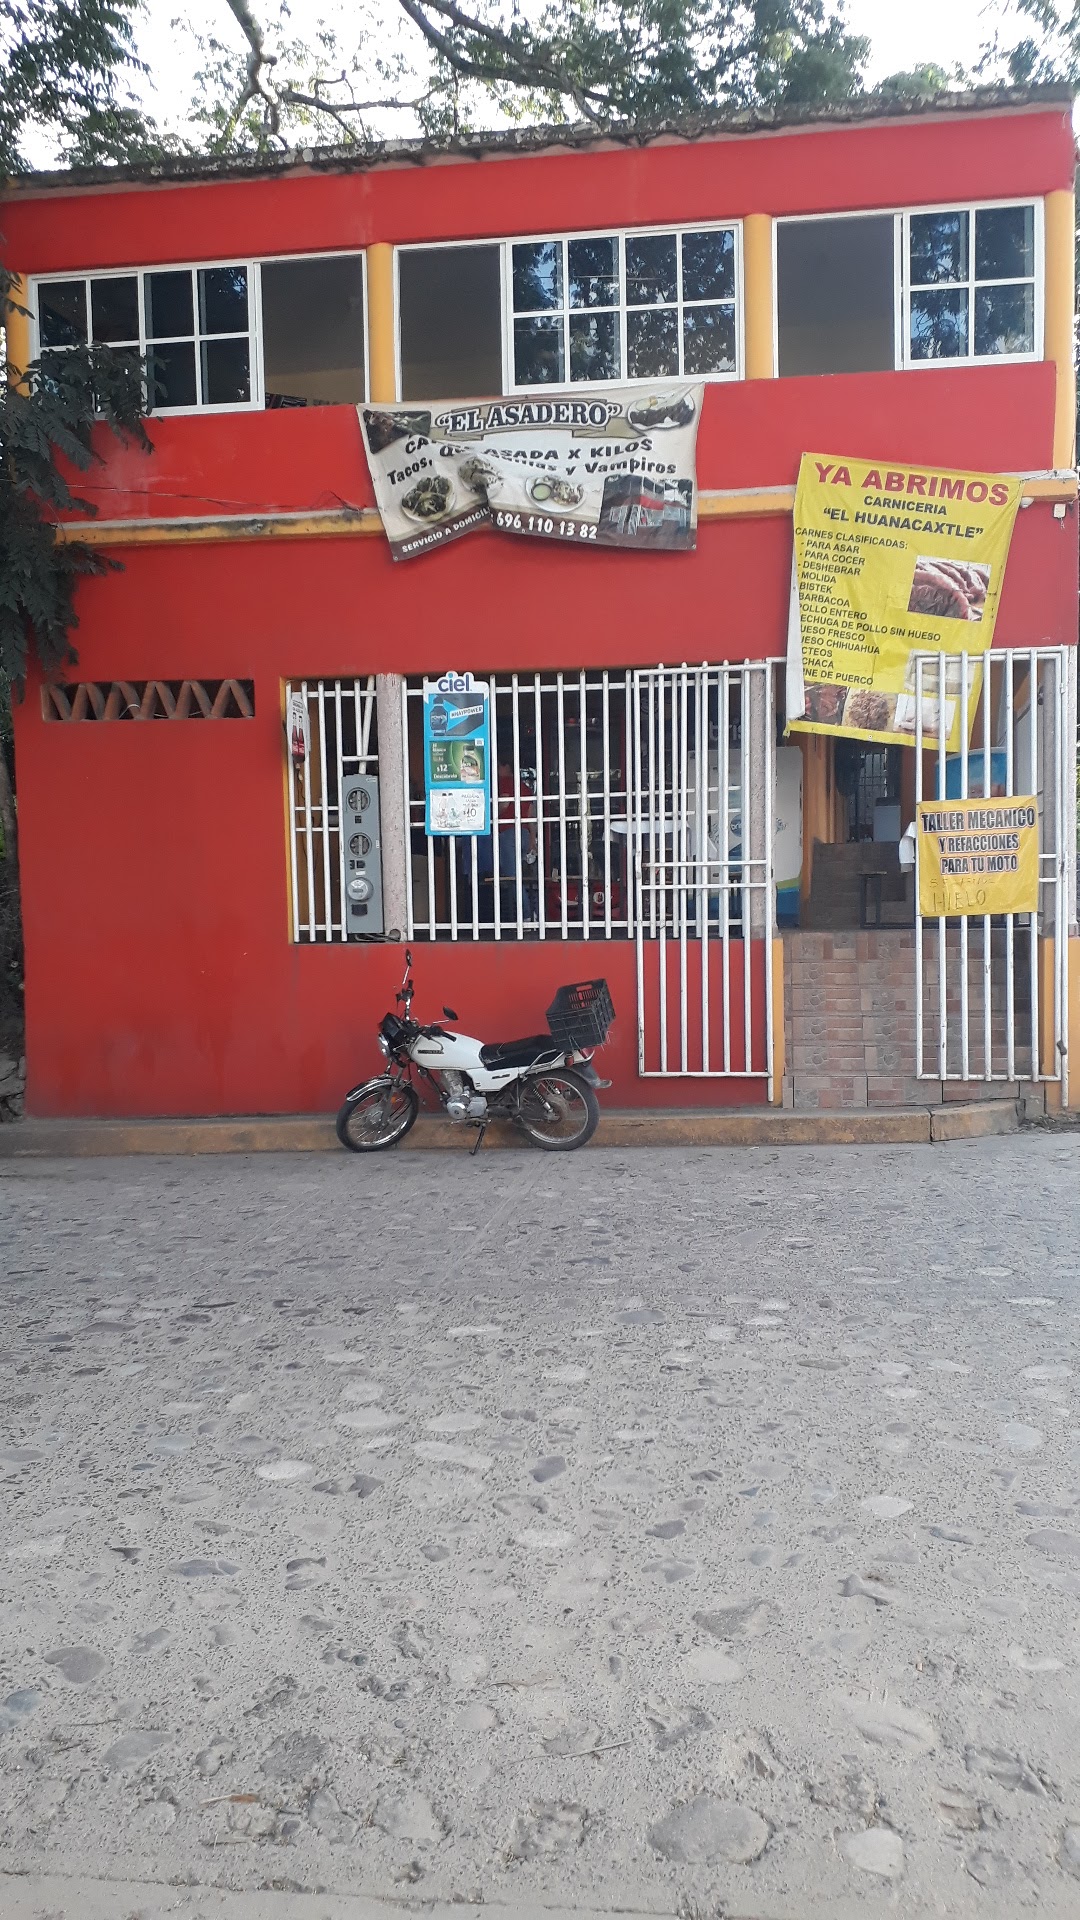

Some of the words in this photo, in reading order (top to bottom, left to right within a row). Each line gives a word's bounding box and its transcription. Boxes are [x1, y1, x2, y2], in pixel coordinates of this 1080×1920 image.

[568, 448, 580, 460] X
[591, 438, 653, 458] KILOS
[387, 457, 433, 485] Tacos,
[585, 457, 677, 474] Vampiros
[814, 462, 852, 486] YA
[861, 469, 1009, 506] ABRIMOS
[864, 495, 947, 516] CARNICERIA
[497, 512, 522, 529] 696
[528, 516, 553, 534] 110
[559, 520, 575, 536] 13
[580, 525, 597, 540] 82
[795, 527, 834, 540] CARNES
[401, 531, 443, 553] SERVICIO
[445, 527, 452, 536] A
[806, 539, 831, 551] PARA
[833, 543, 860, 554] ASAR
[804, 550, 829, 562] PARA
[831, 554, 866, 566] COCER
[802, 560, 861, 576] DESHEBRAR
[801, 571, 837, 584] MOLIDA
[799, 581, 833, 594] BISTEK
[798, 592, 850, 608] BARBACOA
[829, 608, 868, 620] ENTERO
[800, 614, 839, 627] ECHUGA
[841, 620, 854, 630] DE
[856, 622, 888, 635] POLLO
[890, 627, 906, 637] SIN
[908, 630, 941, 642] HUESO
[801, 625, 827, 636] UESO
[828, 628, 866, 642] FRESCO
[826, 640, 880, 655] CHIHUAHUA
[438, 673, 471, 692] ciel
[820, 670, 834, 680] DE
[835, 672, 874, 686] PUERCO
[921, 812, 965, 832] TALLER
[967, 805, 1036, 830] MECANICO
[938, 836, 947, 853] Y
[948, 833, 1019, 852] REFACCIONES
[941, 857, 968, 874] PARA
[971, 857, 984, 872] TU
[987, 855, 1018, 871] MOTO
[933, 889, 986, 912] HIELO
